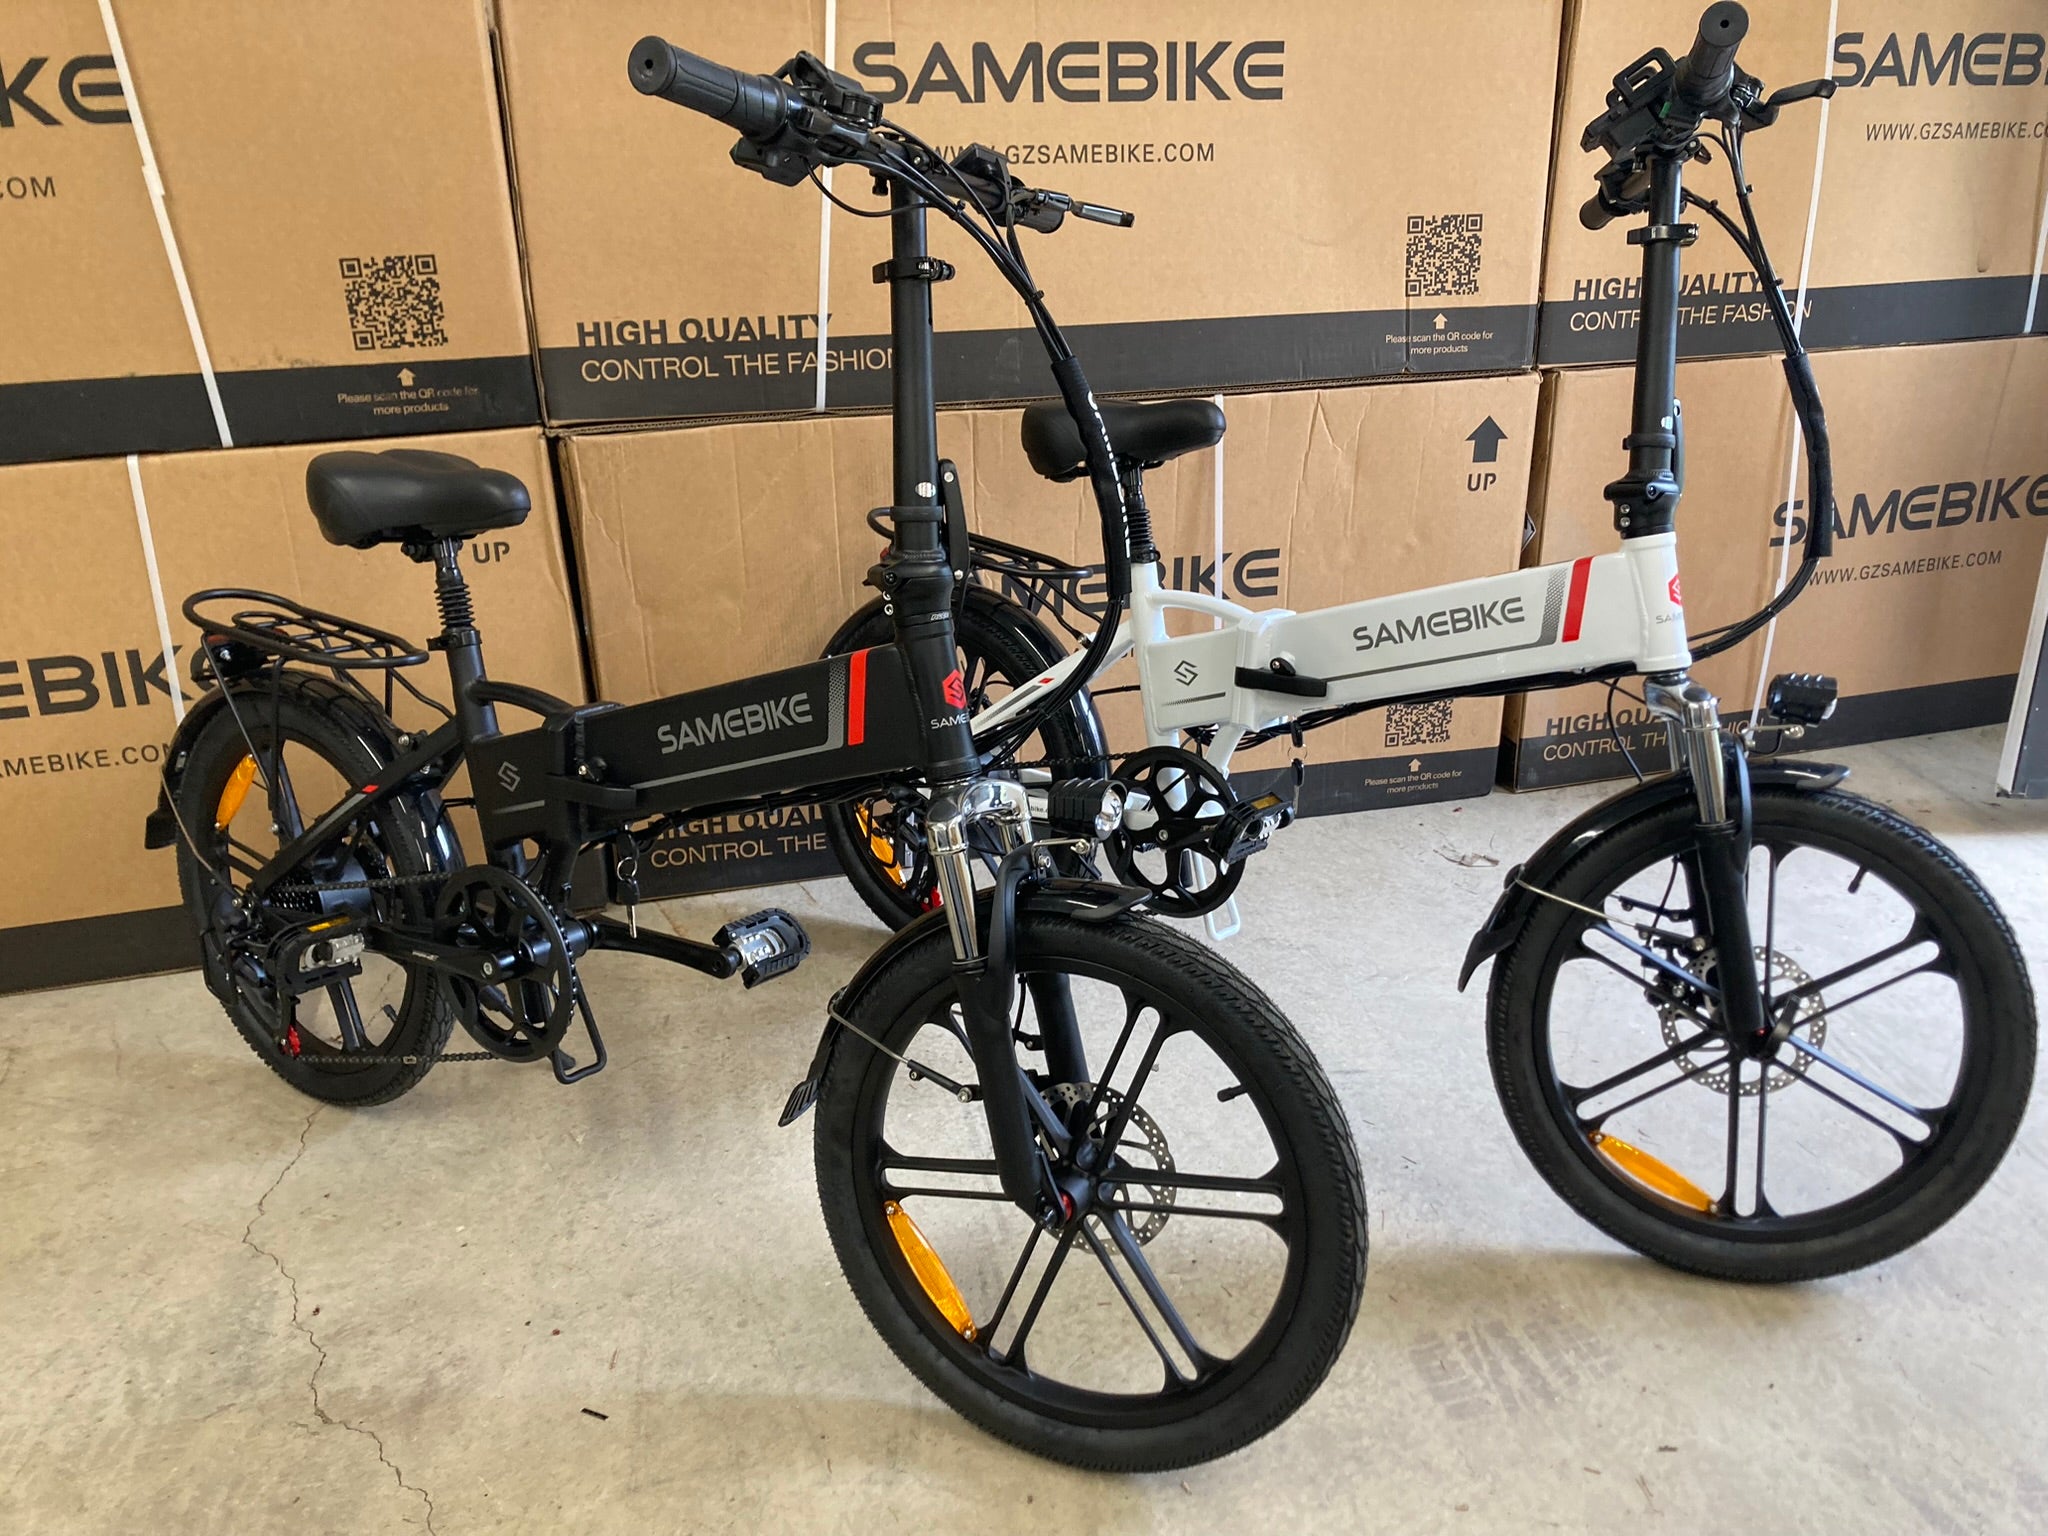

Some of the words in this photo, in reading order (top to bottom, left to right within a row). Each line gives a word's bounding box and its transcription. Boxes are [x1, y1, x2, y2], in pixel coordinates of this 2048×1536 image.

[1832, 32, 2048, 87] SAMEB
[852, 41, 1285, 103] SAMEBIKE
[1573, 277, 1642, 301] HIGH
[1678, 305, 1719, 326] THE
[577, 319, 668, 347] HIGH
[1412, 334, 1432, 342] scan
[1433, 333, 1446, 341] the
[1447, 331, 1460, 341] QR
[1461, 331, 1481, 340] code
[1482, 330, 1494, 340] for
[1410, 346, 1432, 355] more
[1433, 344, 1468, 355] products
[581, 356, 720, 383] CONTROL
[724, 353, 780, 377] THE
[337, 393, 371, 404] Please
[399, 390, 417, 400] the
[418, 388, 435, 399] QR
[373, 406, 401, 416] more
[403, 402, 450, 416] products
[1467, 473, 1497, 491] UP
[472, 541, 510, 564] UP
[1809, 550, 2003, 586] WWW.GZSAMEBIKE.COM
[1353, 596, 1526, 652] SAMEBIKE
[657, 692, 814, 754] SAMEBIKE
[930, 713, 969, 729] SAME
[1546, 711, 1608, 737] HIGH
[1543, 735, 1636, 761] CONTROL
[1641, 731, 1667, 748] TH
[1364, 778, 1388, 786] Please
[1389, 776, 1406, 784] scan
[1407, 774, 1419, 782] the
[1420, 773, 1432, 781] QR
[1432, 771, 1451, 780] code
[1452, 770, 1462, 778] for
[1386, 786, 1407, 794] more
[1407, 782, 1439, 793] products
[651, 839, 773, 868] CONTROL
[777, 832, 827, 854] THE
